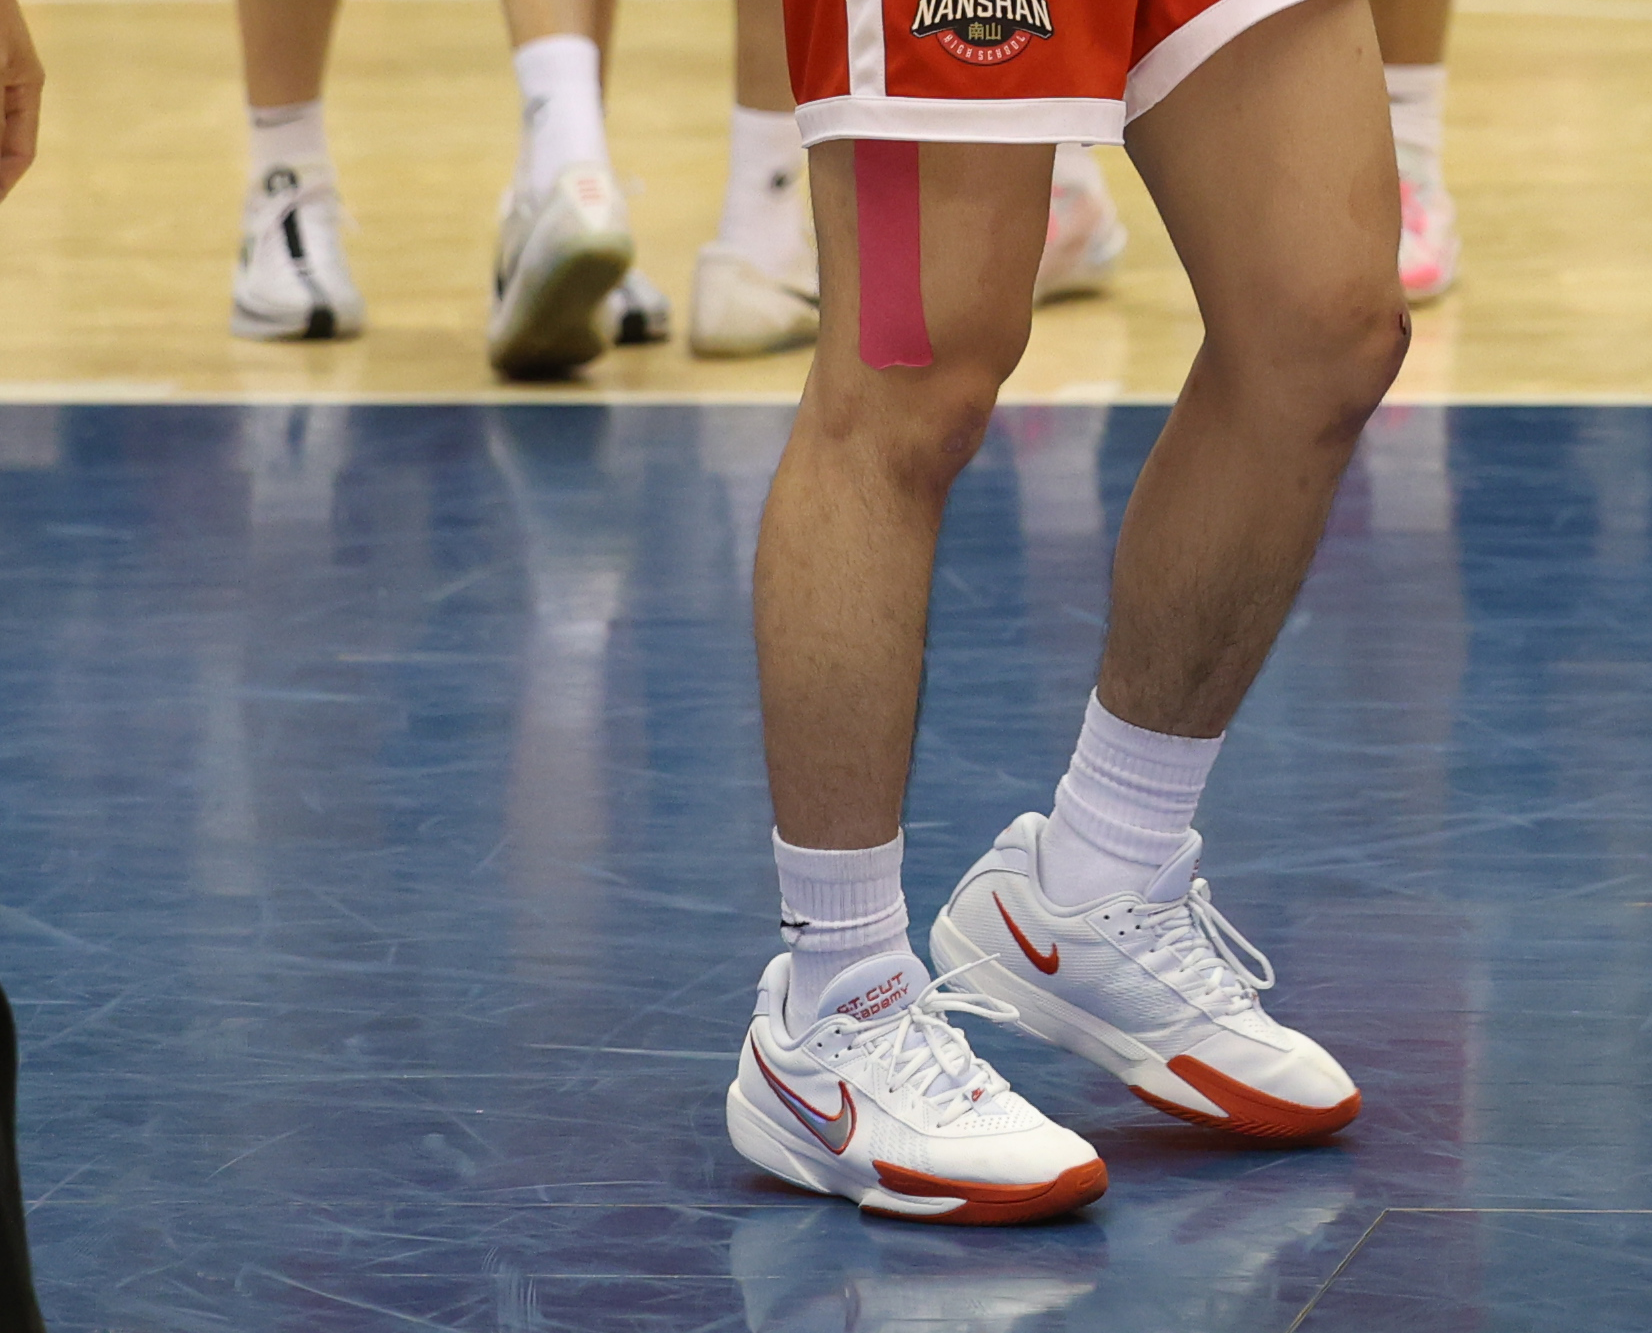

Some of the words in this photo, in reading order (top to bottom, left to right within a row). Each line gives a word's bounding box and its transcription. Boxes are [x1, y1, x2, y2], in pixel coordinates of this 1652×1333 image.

[968, 21, 1002, 41] 南山
[977, 35, 1026, 61] SCHOOL
[866, 971, 903, 1002] CUT
